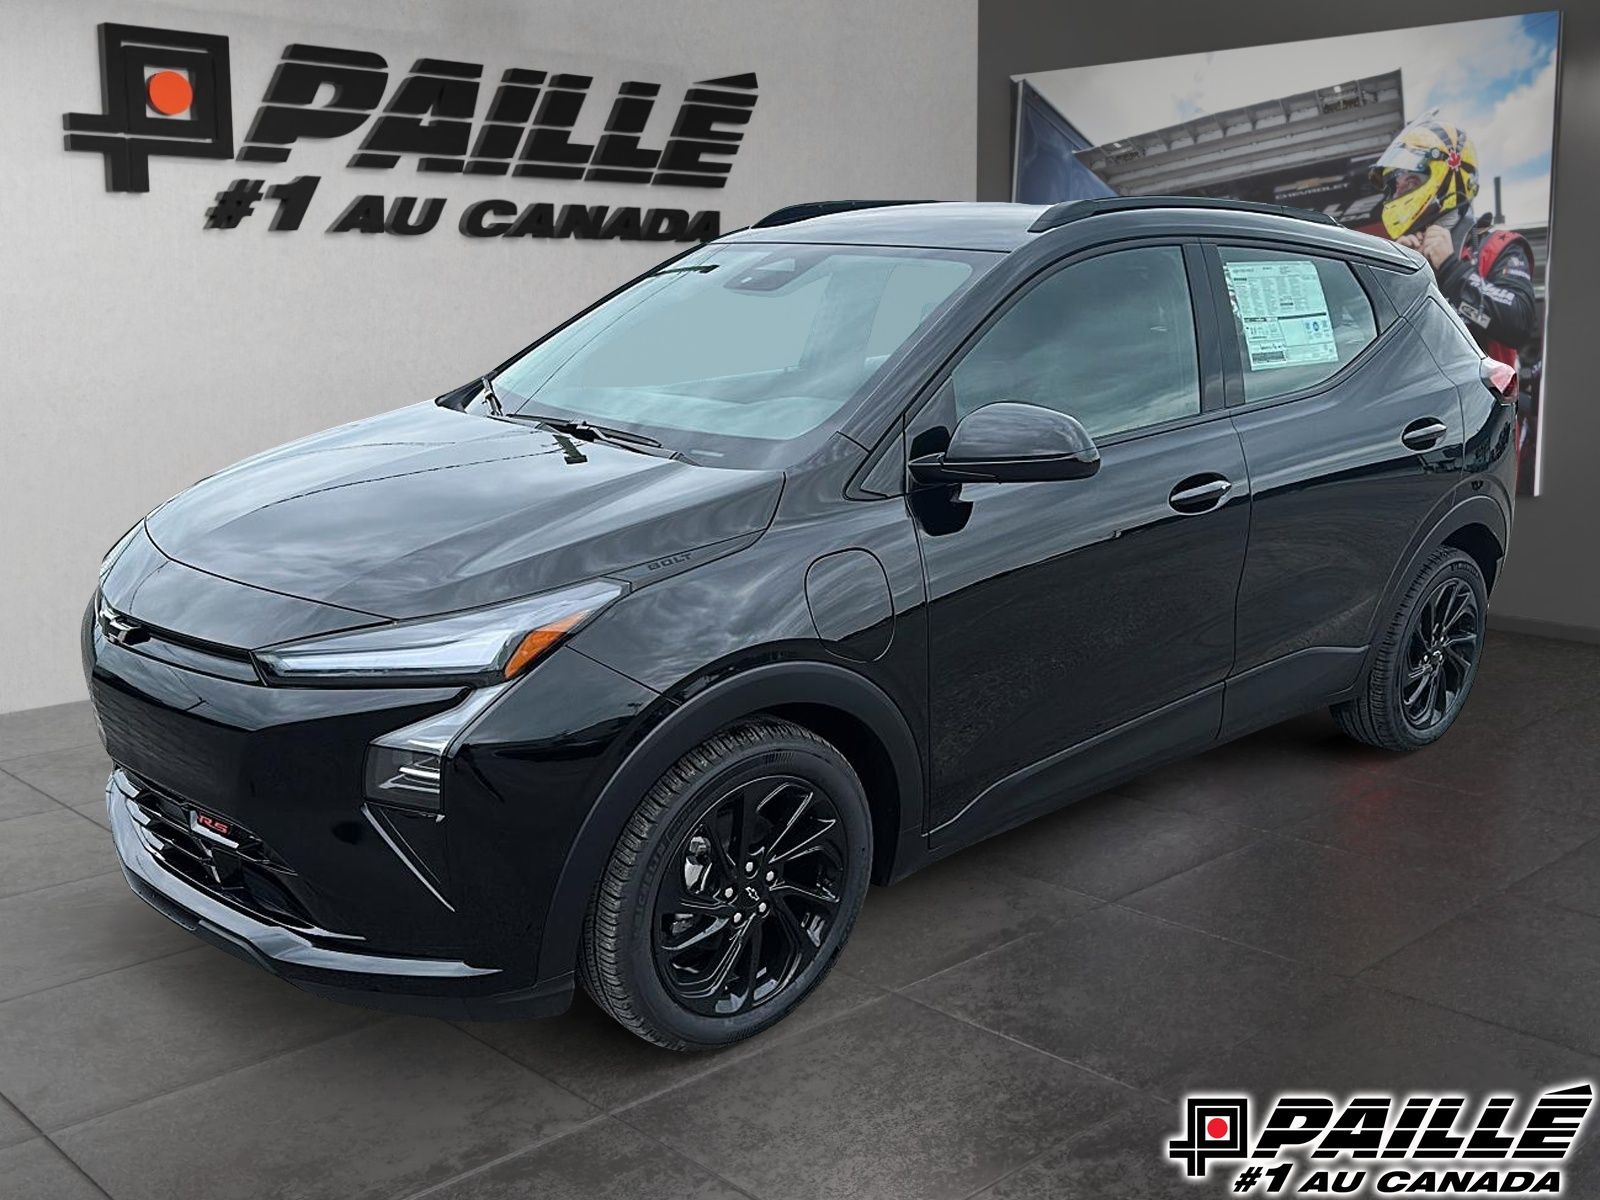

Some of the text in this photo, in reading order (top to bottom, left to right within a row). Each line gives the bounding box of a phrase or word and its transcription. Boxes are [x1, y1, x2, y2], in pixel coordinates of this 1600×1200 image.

[236, 43, 759, 189] PAILLÉ
[204, 175, 722, 243] #1 AU CANADA
[648, 553, 692, 571] BOLT
[199, 815, 228, 834] RS
